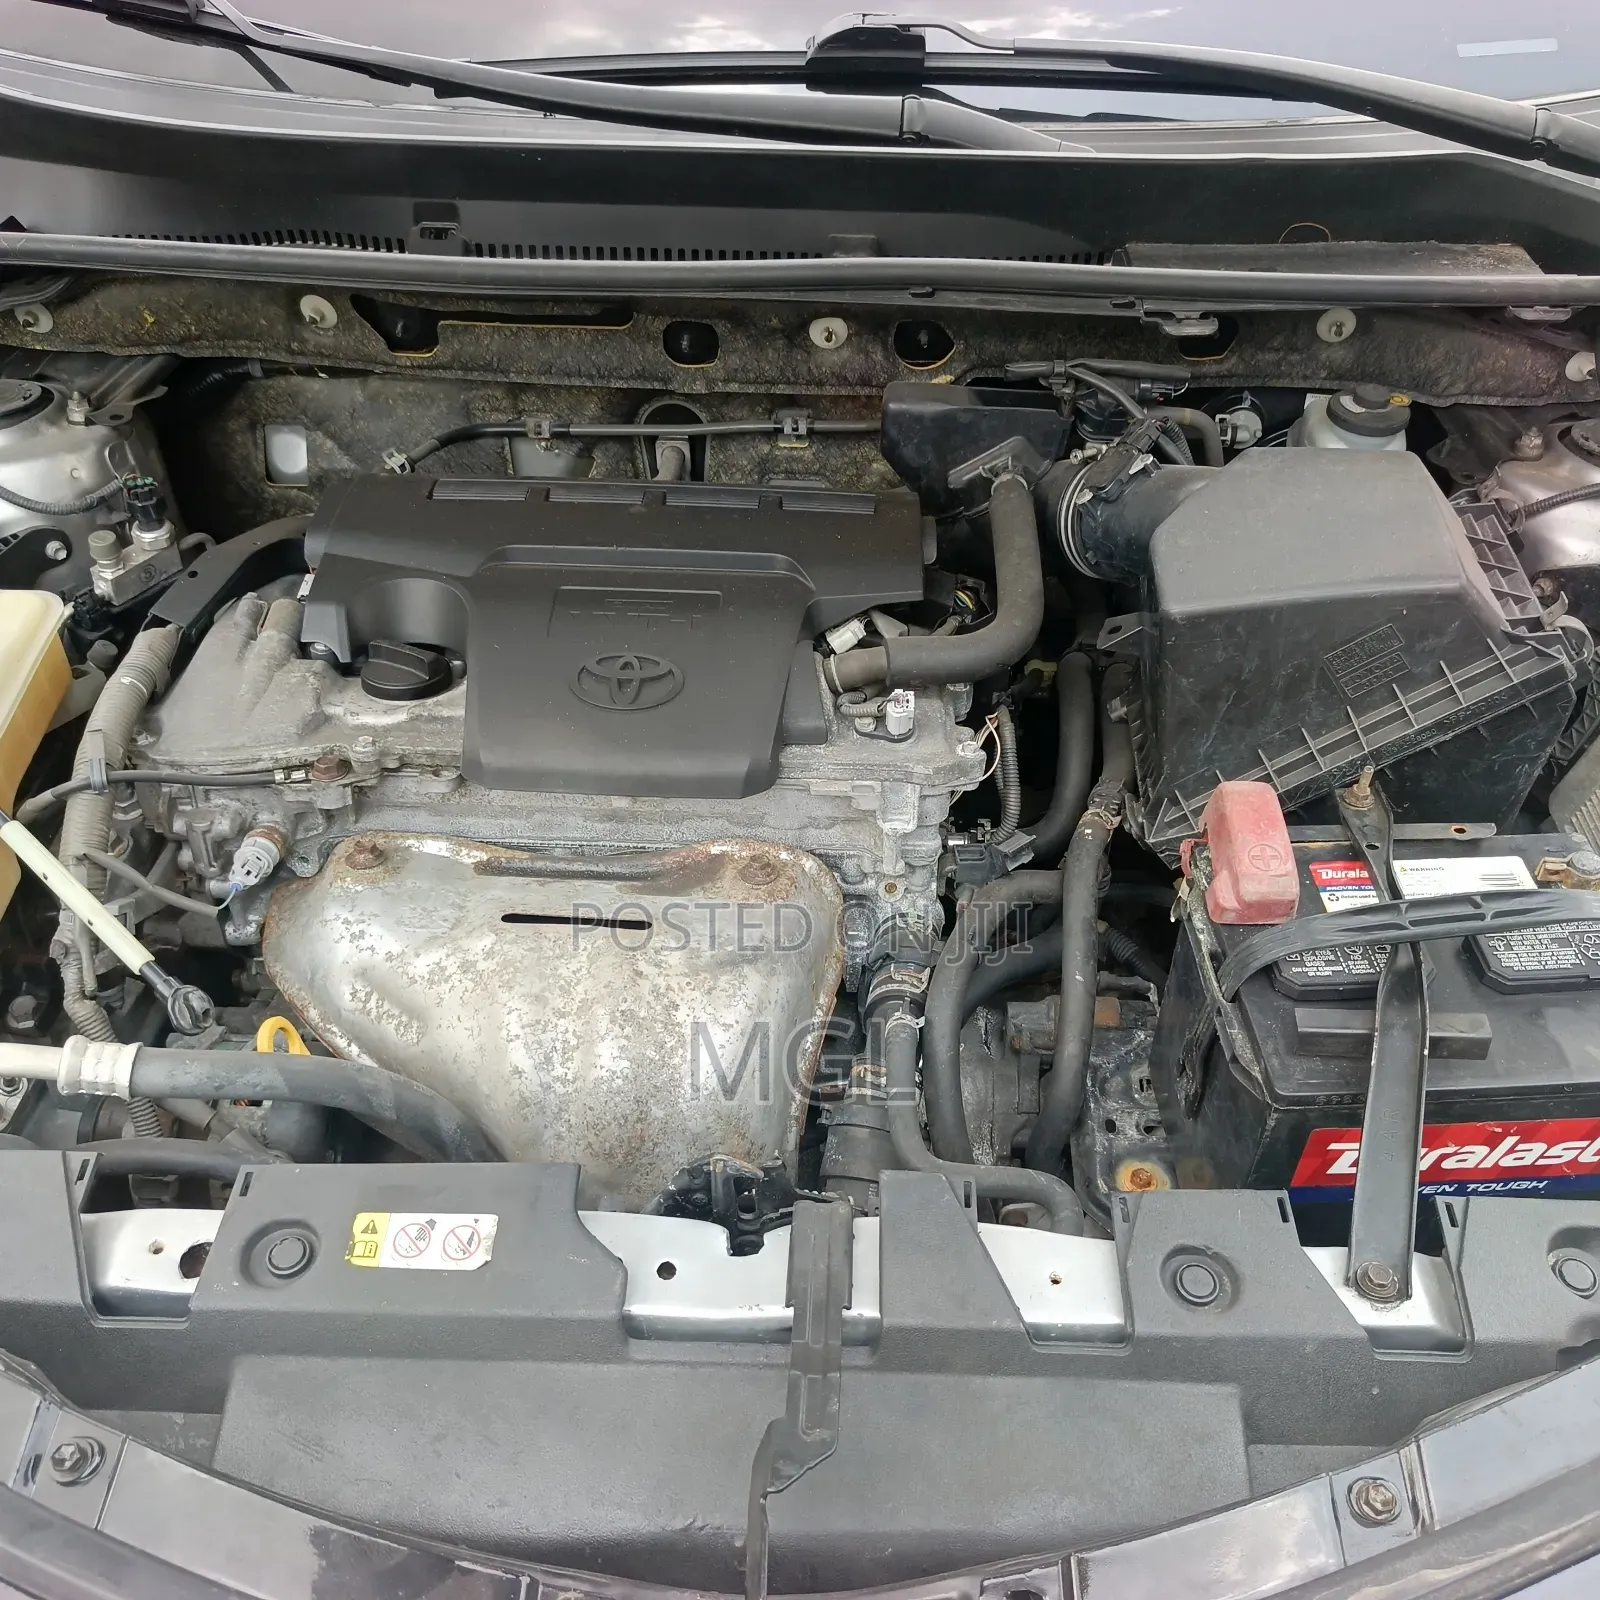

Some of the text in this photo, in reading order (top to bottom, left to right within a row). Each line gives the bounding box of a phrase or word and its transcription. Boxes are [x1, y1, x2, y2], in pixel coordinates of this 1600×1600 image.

[1317, 868, 1369, 879] Durala
[1326, 1136, 1600, 1175] Dralast
[1467, 1180, 1549, 1192] TOUGH
